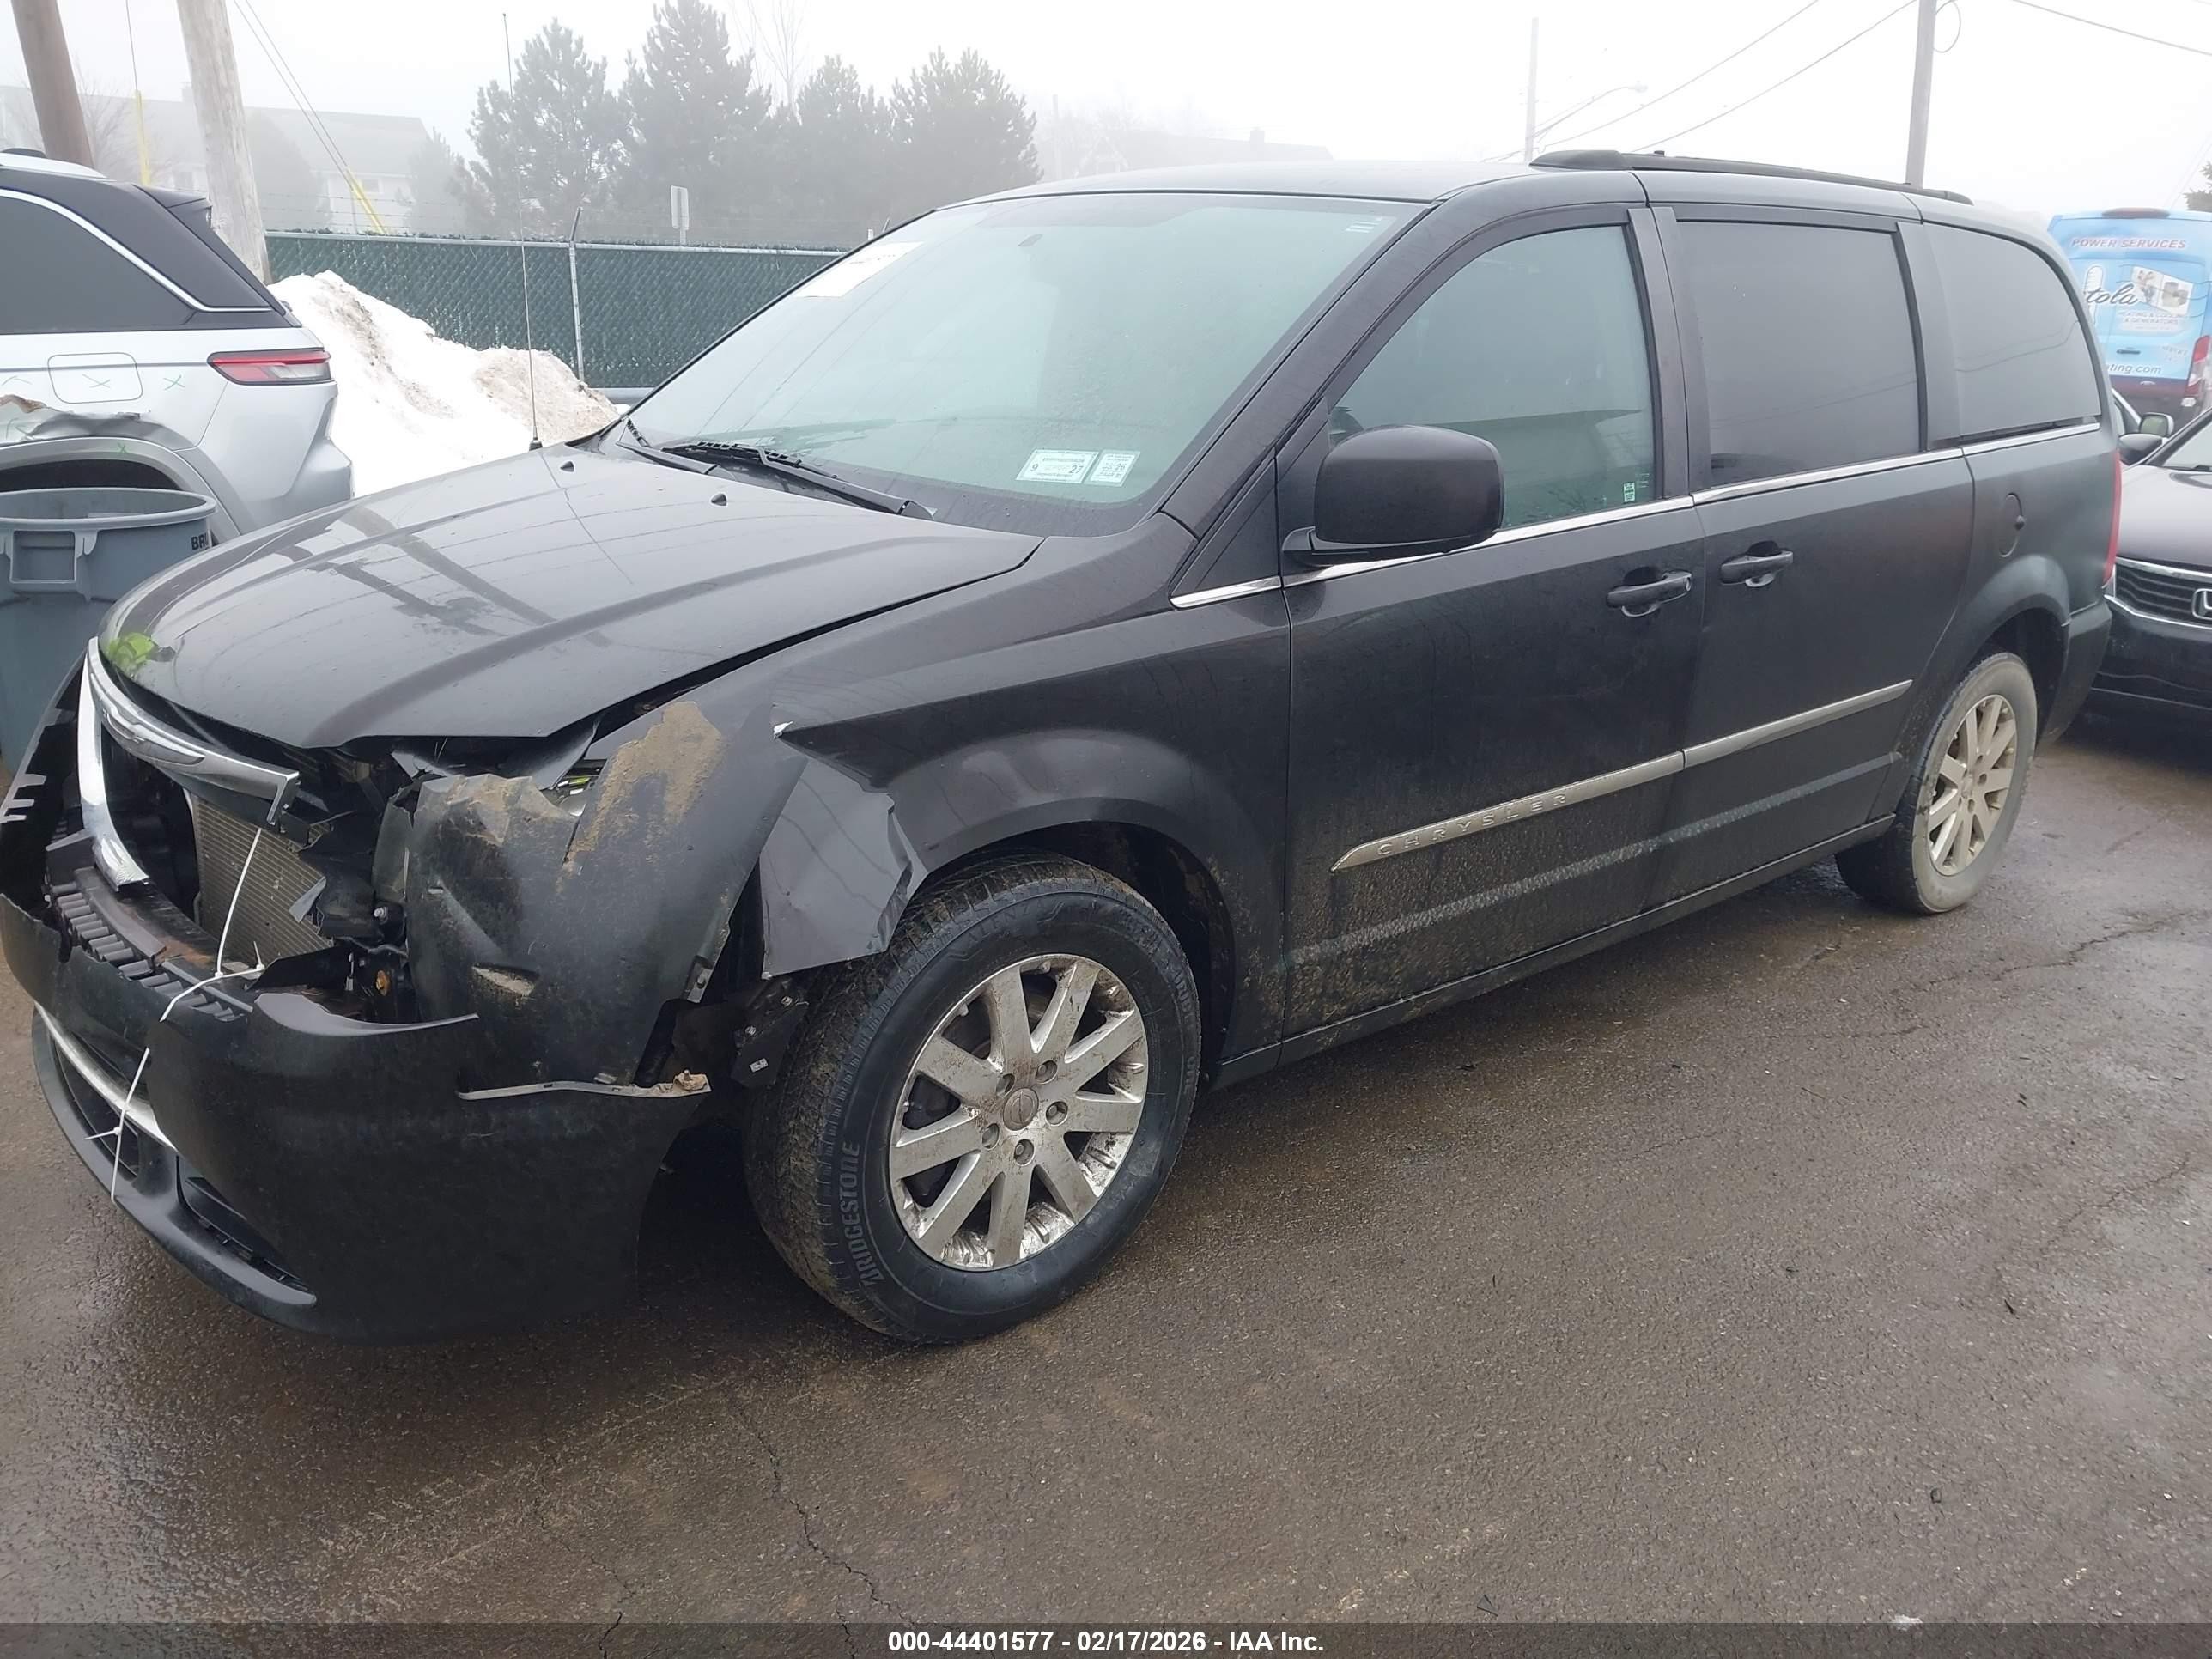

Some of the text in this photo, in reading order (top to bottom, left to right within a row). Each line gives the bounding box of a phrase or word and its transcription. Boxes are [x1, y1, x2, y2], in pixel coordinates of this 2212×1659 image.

[2071, 239, 2185, 248] POWER SERVICES
[1376, 795, 1567, 856] CHRYSLER
[839, 1141, 885, 1287] BRIDGESTONE
